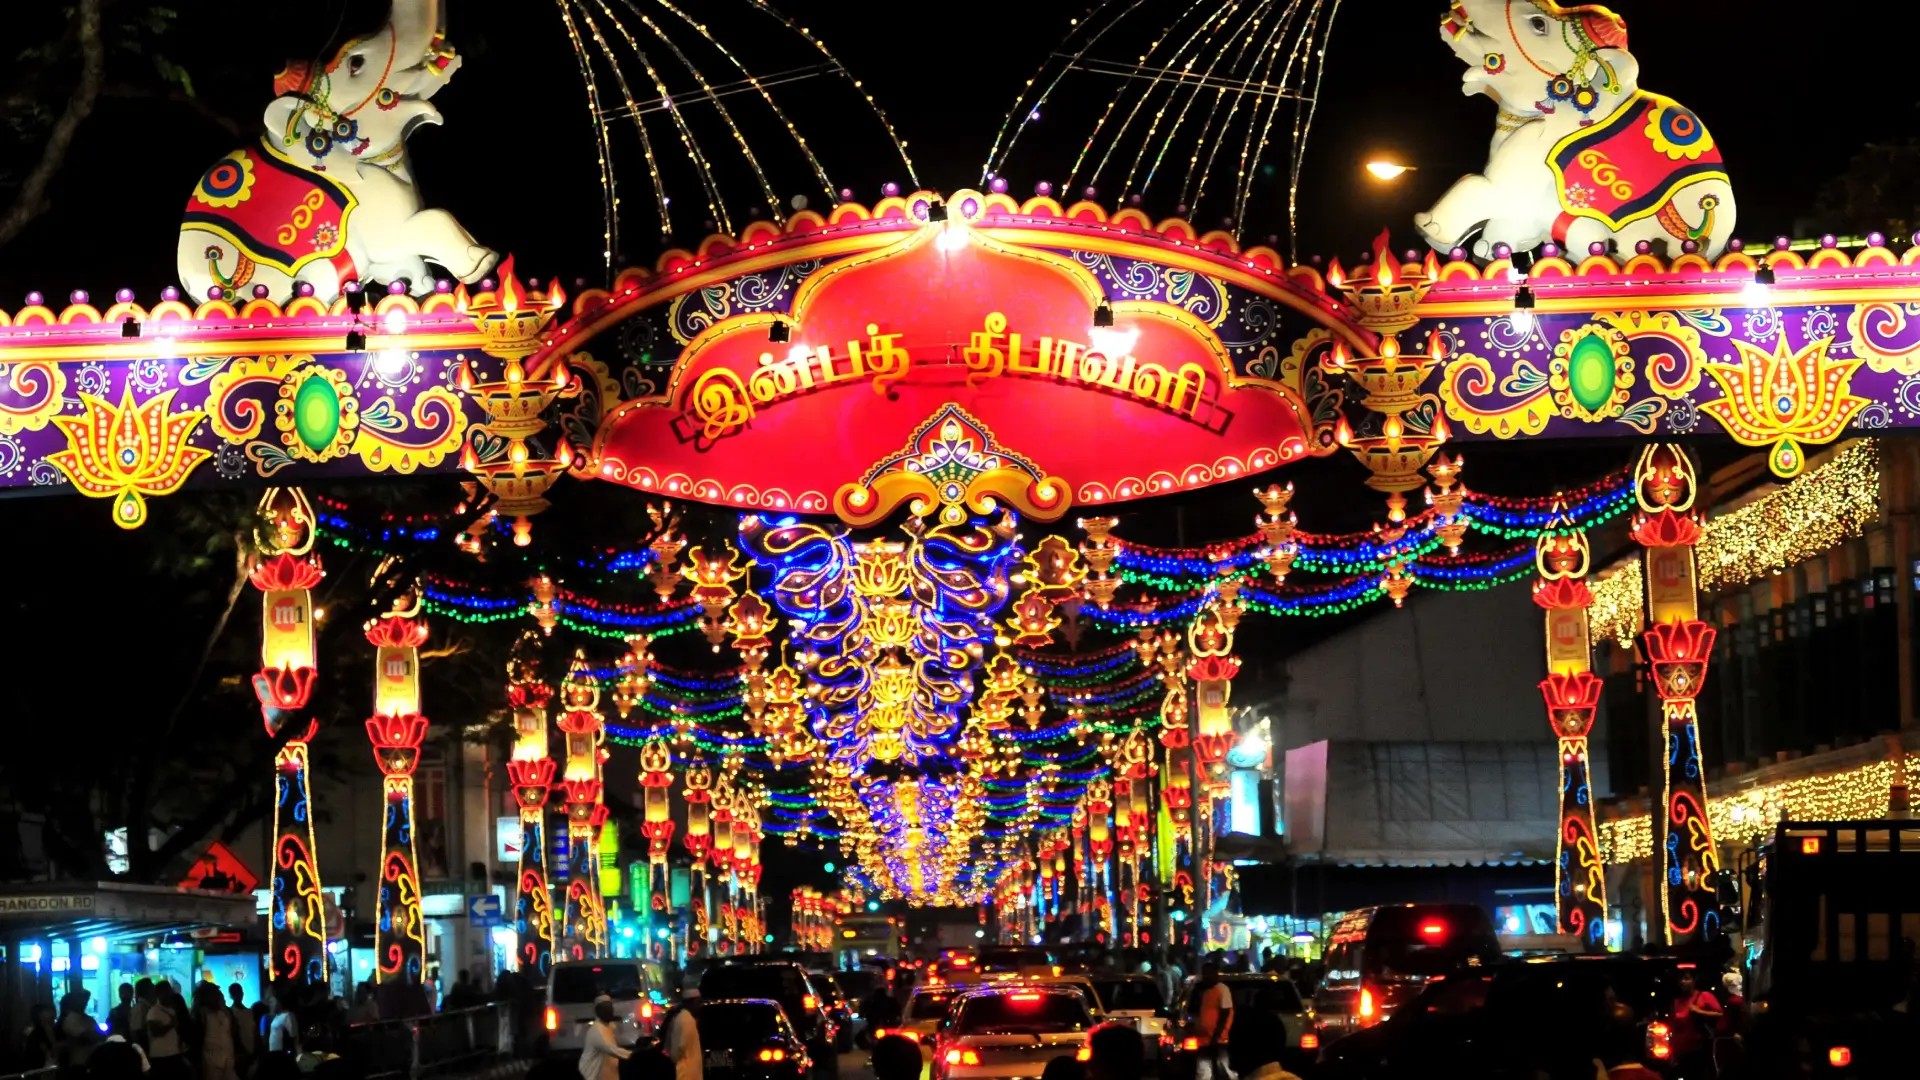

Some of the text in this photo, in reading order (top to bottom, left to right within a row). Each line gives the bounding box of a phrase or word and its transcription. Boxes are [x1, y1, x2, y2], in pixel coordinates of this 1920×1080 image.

[693, 312, 1206, 440] இன்பத் தீபாவளி
[73, 897, 92, 908] RD
